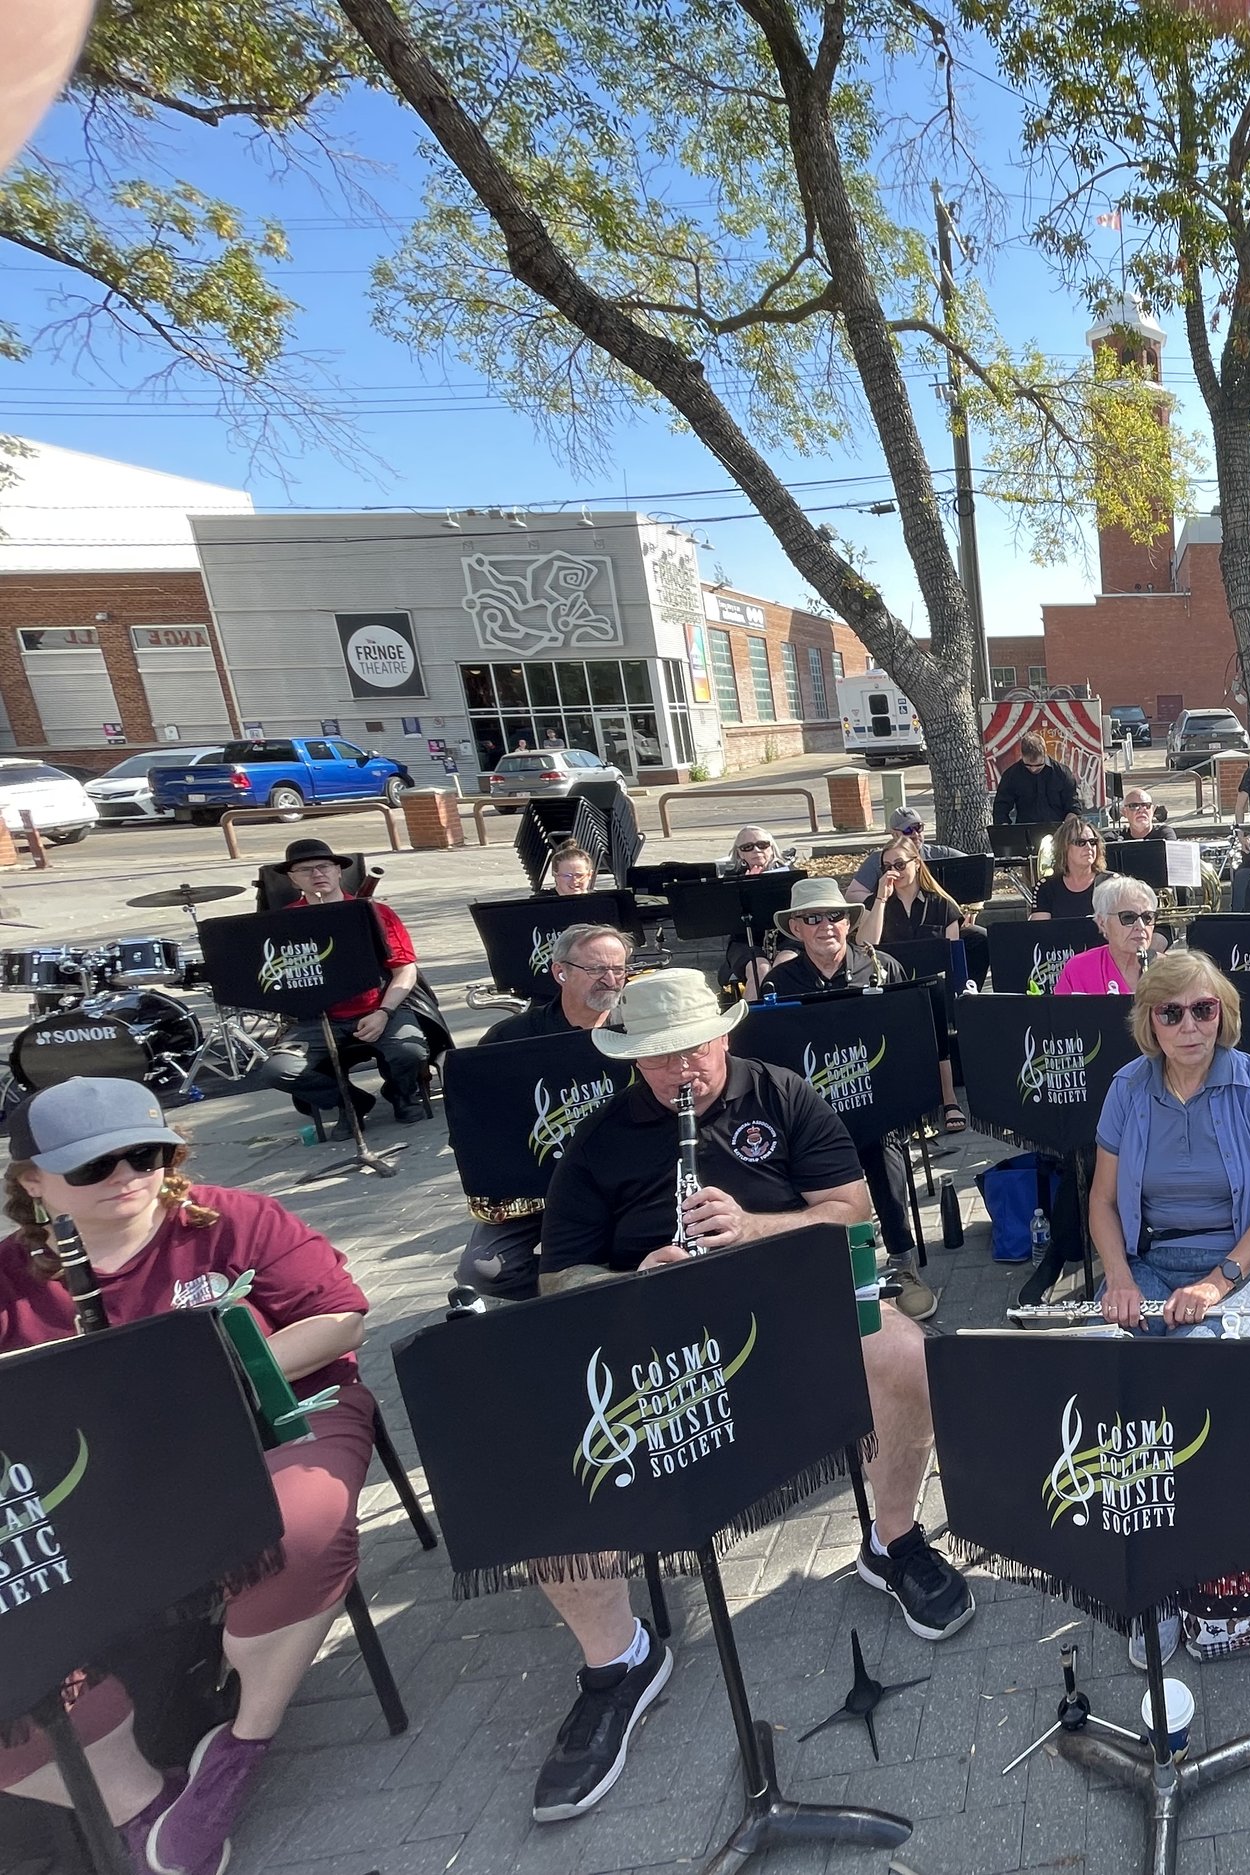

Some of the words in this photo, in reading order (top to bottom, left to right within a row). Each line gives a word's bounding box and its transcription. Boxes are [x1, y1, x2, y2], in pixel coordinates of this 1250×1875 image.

[359, 661, 408, 674] THEATRE
[281, 942, 318, 957] COSMO
[286, 964, 323, 979] MUSIC
[287, 976, 324, 989] SOCIETY
[52, 1025, 117, 1044] SONOR
[824, 1045, 867, 1067] COSMO
[1042, 1038, 1083, 1055] COSMO
[827, 1062, 869, 1081] POLITAN
[1044, 1056, 1084, 1070] POLITAN
[830, 1076, 872, 1100] MUSIC
[1046, 1071, 1086, 1089] MUSIC
[560, 1078, 614, 1105] COSMO
[1047, 1090, 1087, 1104] SOCIETY
[831, 1092, 874, 1114] SOCIETY
[631, 1338, 721, 1391] COSMO
[638, 1367, 726, 1419] POLITAN
[643, 1392, 732, 1452] MUSIC
[1097, 1420, 1174, 1452] COSMO
[650, 1421, 736, 1478] SOCIETY
[1100, 1450, 1174, 1479] POLITAN
[1101, 1476, 1176, 1511] MUSIC
[1102, 1507, 1176, 1537] SOCIETY
[0, 1525, 60, 1579] SIC
